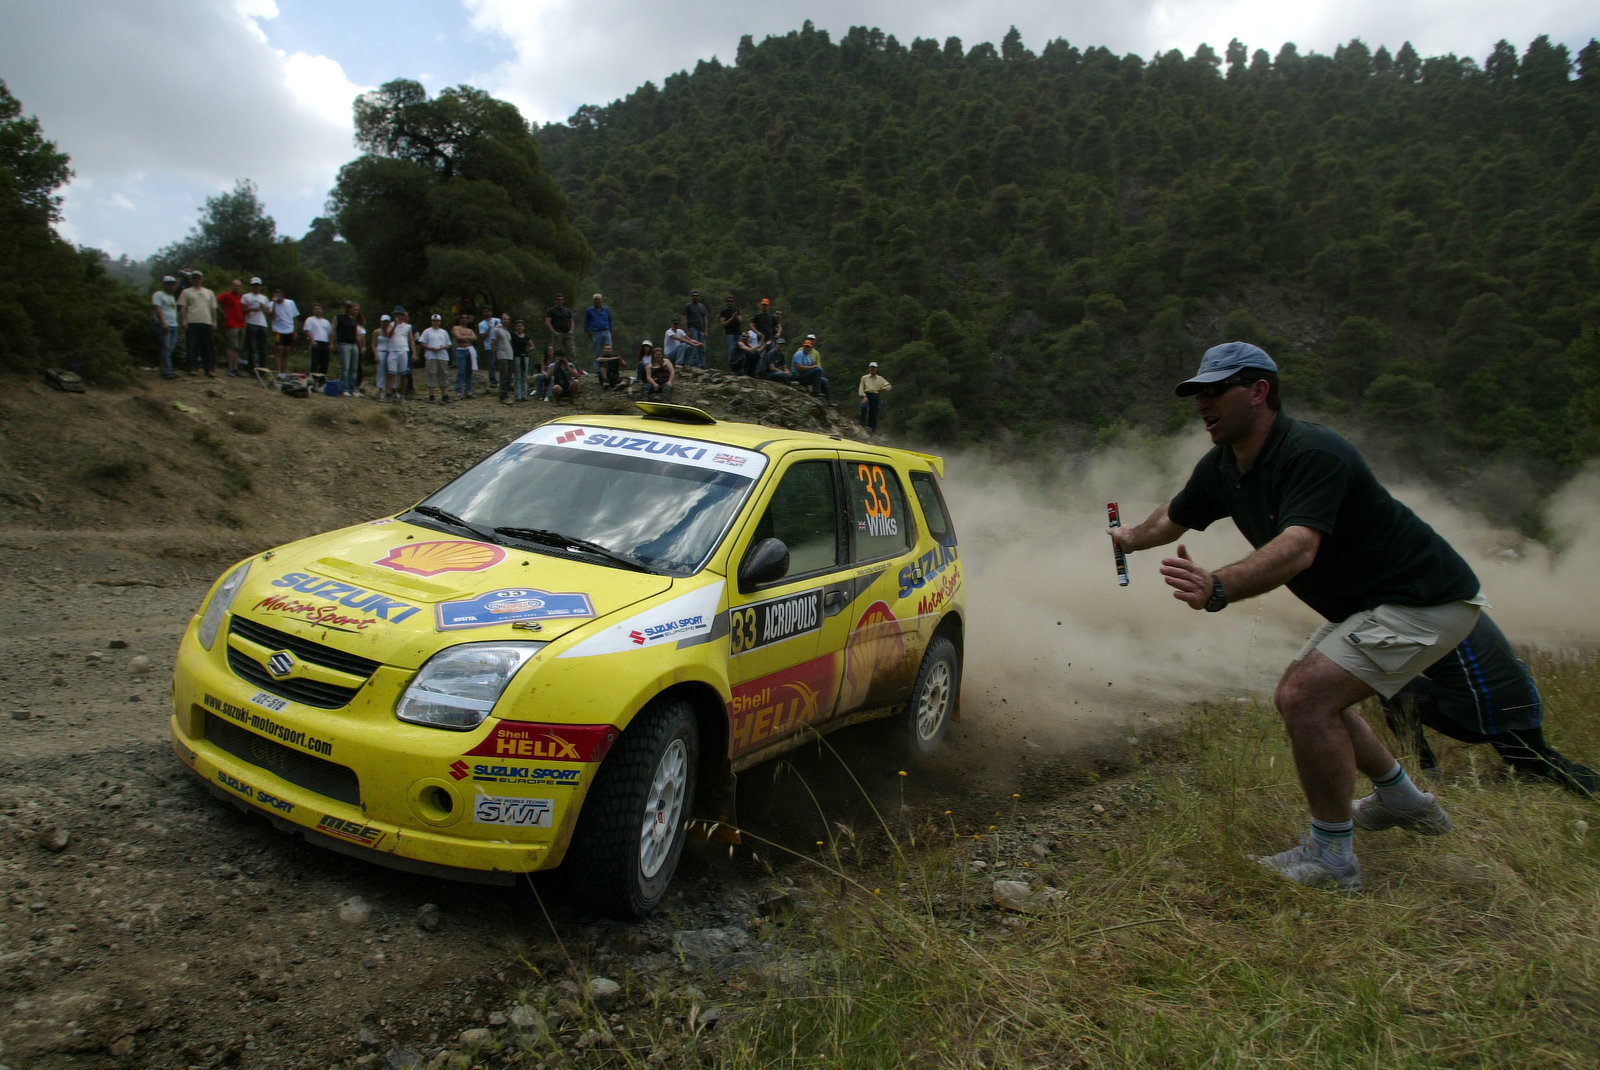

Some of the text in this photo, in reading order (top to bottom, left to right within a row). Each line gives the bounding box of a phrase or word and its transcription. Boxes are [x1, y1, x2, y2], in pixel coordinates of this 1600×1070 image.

[583, 433, 708, 460] SUZUKI
[858, 463, 892, 518] 33
[865, 512, 898, 537] Wilks
[898, 536, 959, 599] SUZUKI
[271, 572, 422, 624] SUZUKI
[644, 615, 703, 636] SUZUKI SPORT
[732, 594, 818, 653] 33 ACROPOLIS
[732, 687, 772, 714] Shell
[204, 693, 333, 757] www.suzuki-motorsport.com
[732, 684, 819, 750] HELIX
[496, 734, 581, 759] HELIX
[497, 729, 529, 739] Shell
[473, 764, 581, 780] SUZUKI SPORT
[499, 777, 554, 785] EUROPE
[217, 771, 297, 814] SUZUKI SPORT
[477, 801, 550, 825] SWT
